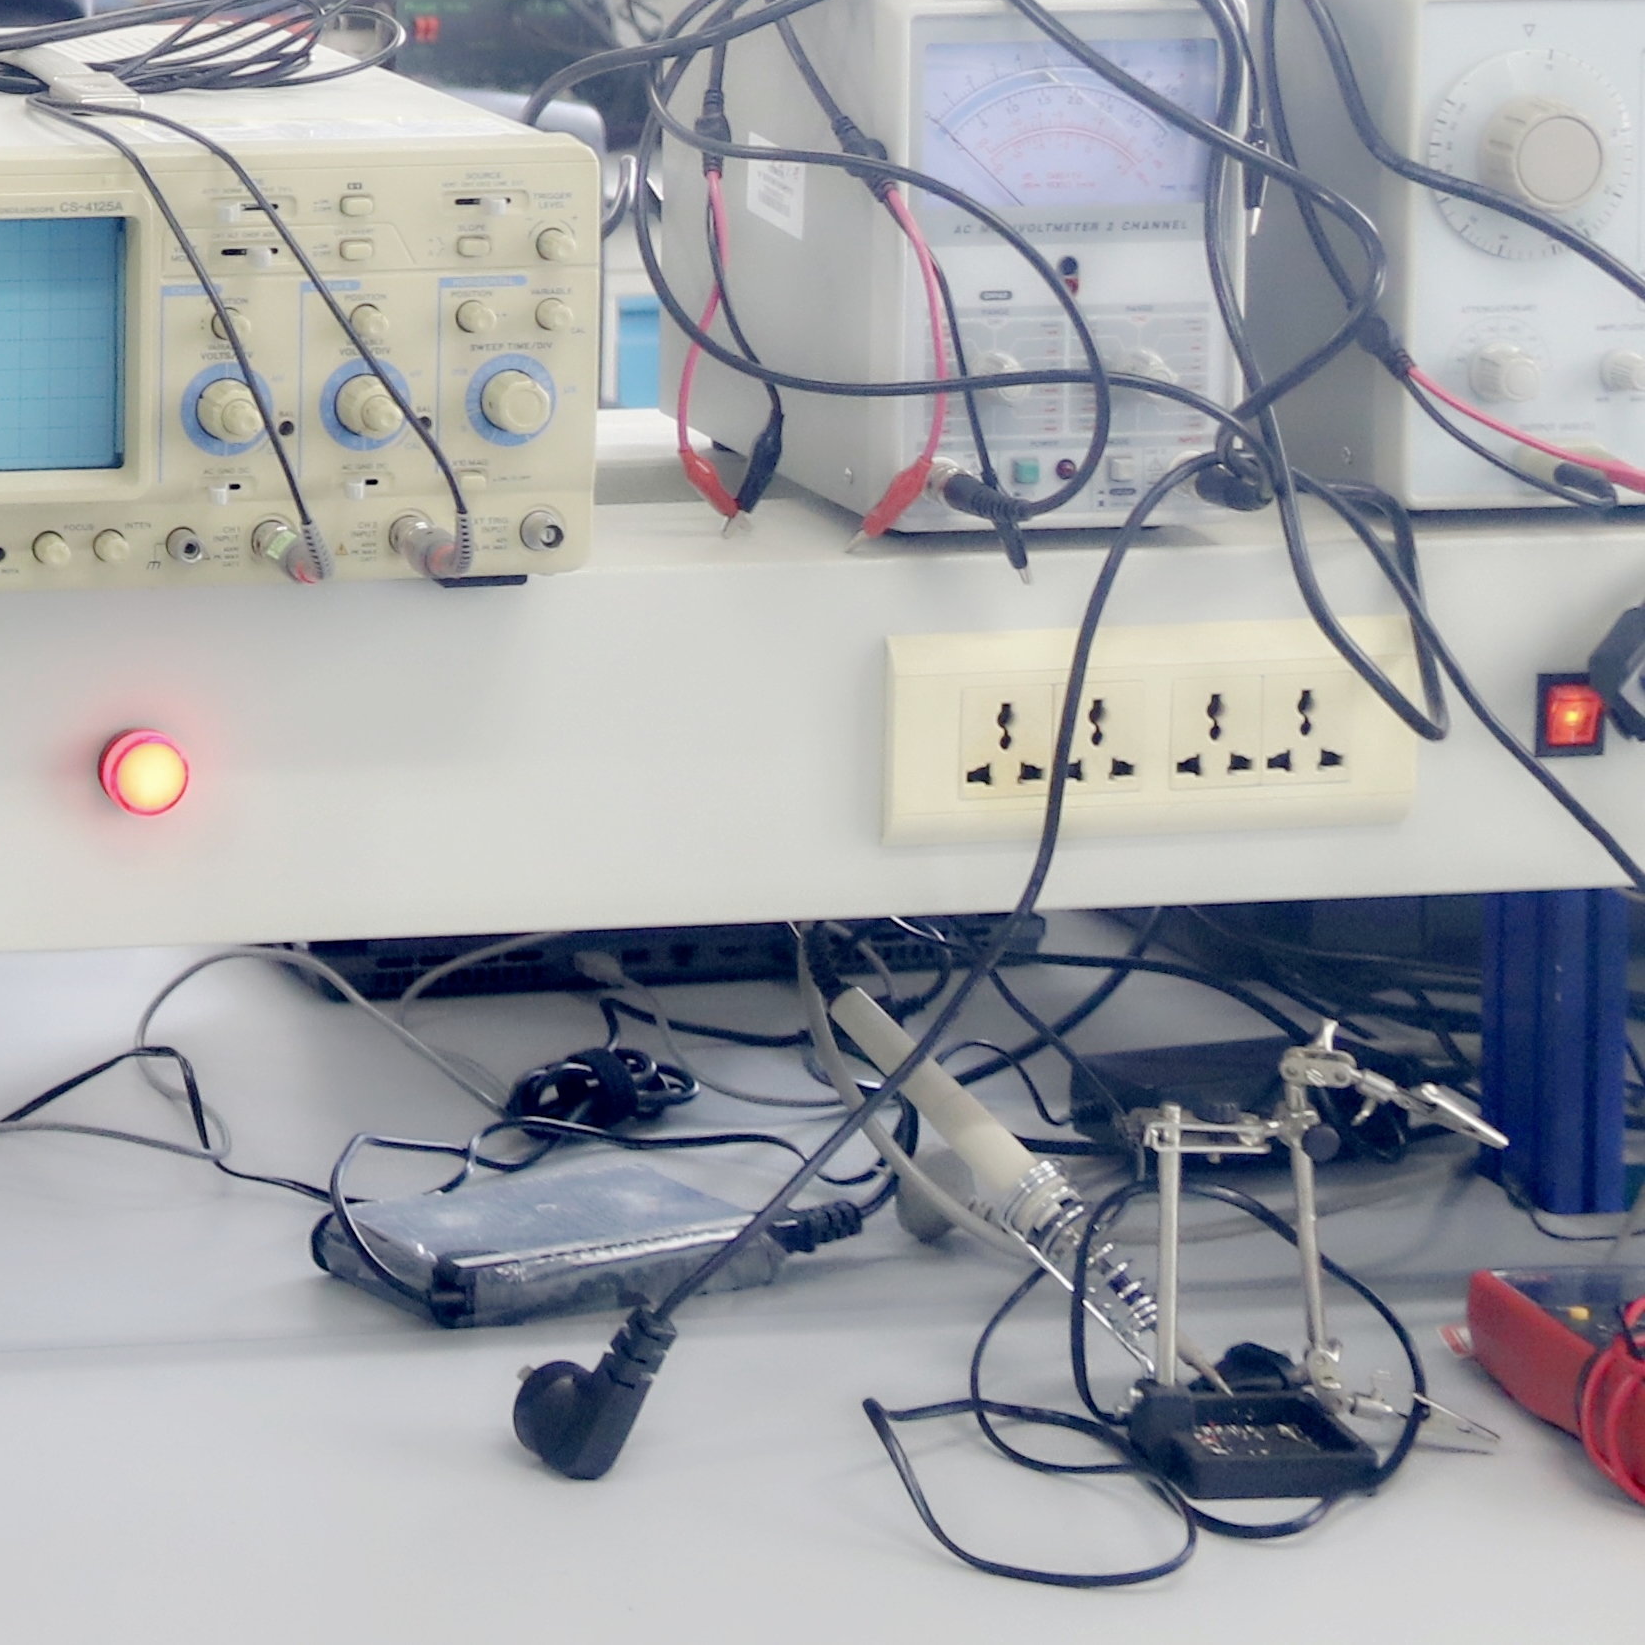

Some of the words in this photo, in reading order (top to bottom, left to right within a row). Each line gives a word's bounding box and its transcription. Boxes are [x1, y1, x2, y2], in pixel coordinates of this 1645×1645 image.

[465, 172, 502, 180] SOURCE
[532, 192, 573, 200] TRIGGER
[59, 201, 124, 214] CS-4125A
[538, 201, 566, 209] LEVEL
[458, 224, 486, 232] SLOPE
[954, 224, 971, 234] AC
[1121, 220, 1189, 232] CHANNEL
[451, 290, 493, 298] POSITION
[531, 288, 572, 296] VARIABLE
[344, 294, 387, 302] POSITION
[470, 343, 504, 352] SWEEP
[507, 342, 553, 351] TIME/DIV
[64, 524, 94, 532] FOCUS
[124, 522, 152, 530] INTEN
